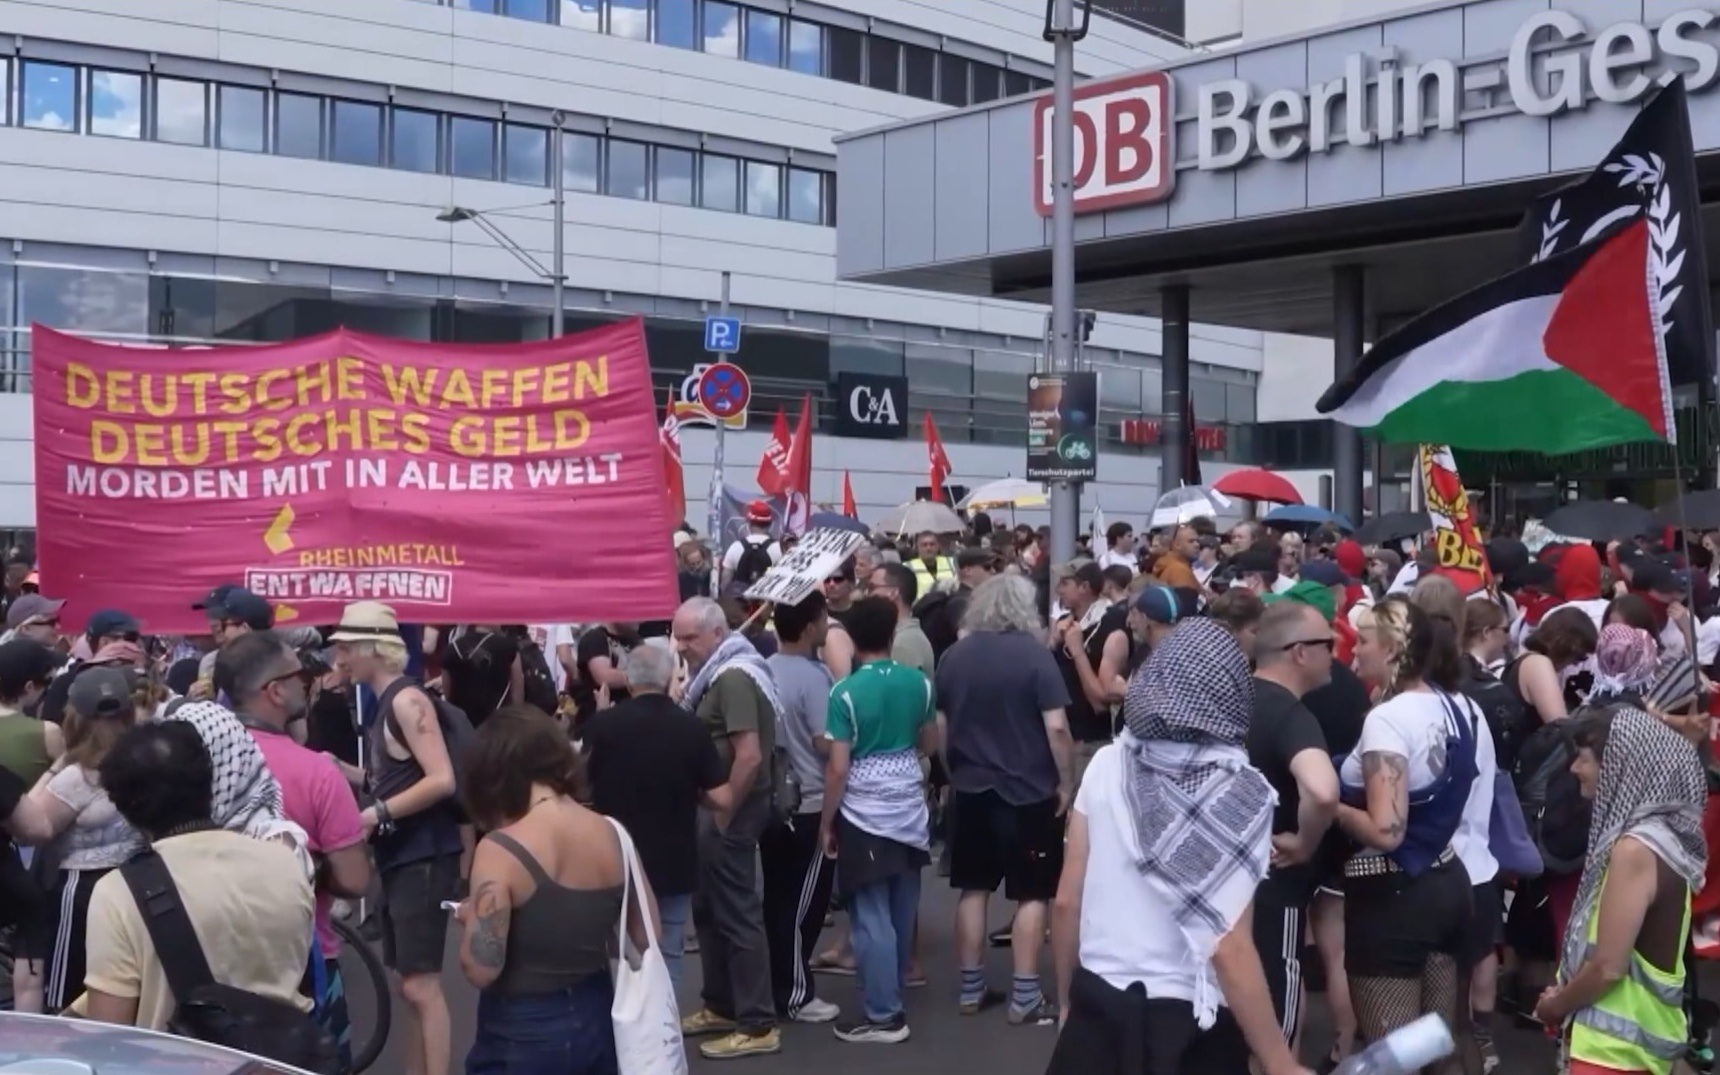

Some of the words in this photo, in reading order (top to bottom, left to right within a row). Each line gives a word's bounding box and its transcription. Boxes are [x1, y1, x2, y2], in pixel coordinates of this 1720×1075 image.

[1052, 97, 1153, 190] DB
[710, 321, 730, 348] P
[66, 358, 366, 417] DEUTSCHE
[381, 355, 609, 409] WAFFEN
[850, 385, 900, 425] C&A
[91, 408, 430, 466] DEUTSCHES
[451, 409, 590, 458] GELD
[67, 464, 248, 498] MORDEN
[263, 460, 331, 496] MIT
[346, 458, 387, 488] IN
[398, 461, 514, 491] ALLER
[526, 453, 622, 488] WELT
[1028, 467, 1095, 479] Tierschutzpartei
[300, 543, 465, 567] RHEINMETALL
[251, 571, 446, 599] ENTWAFFNEN
